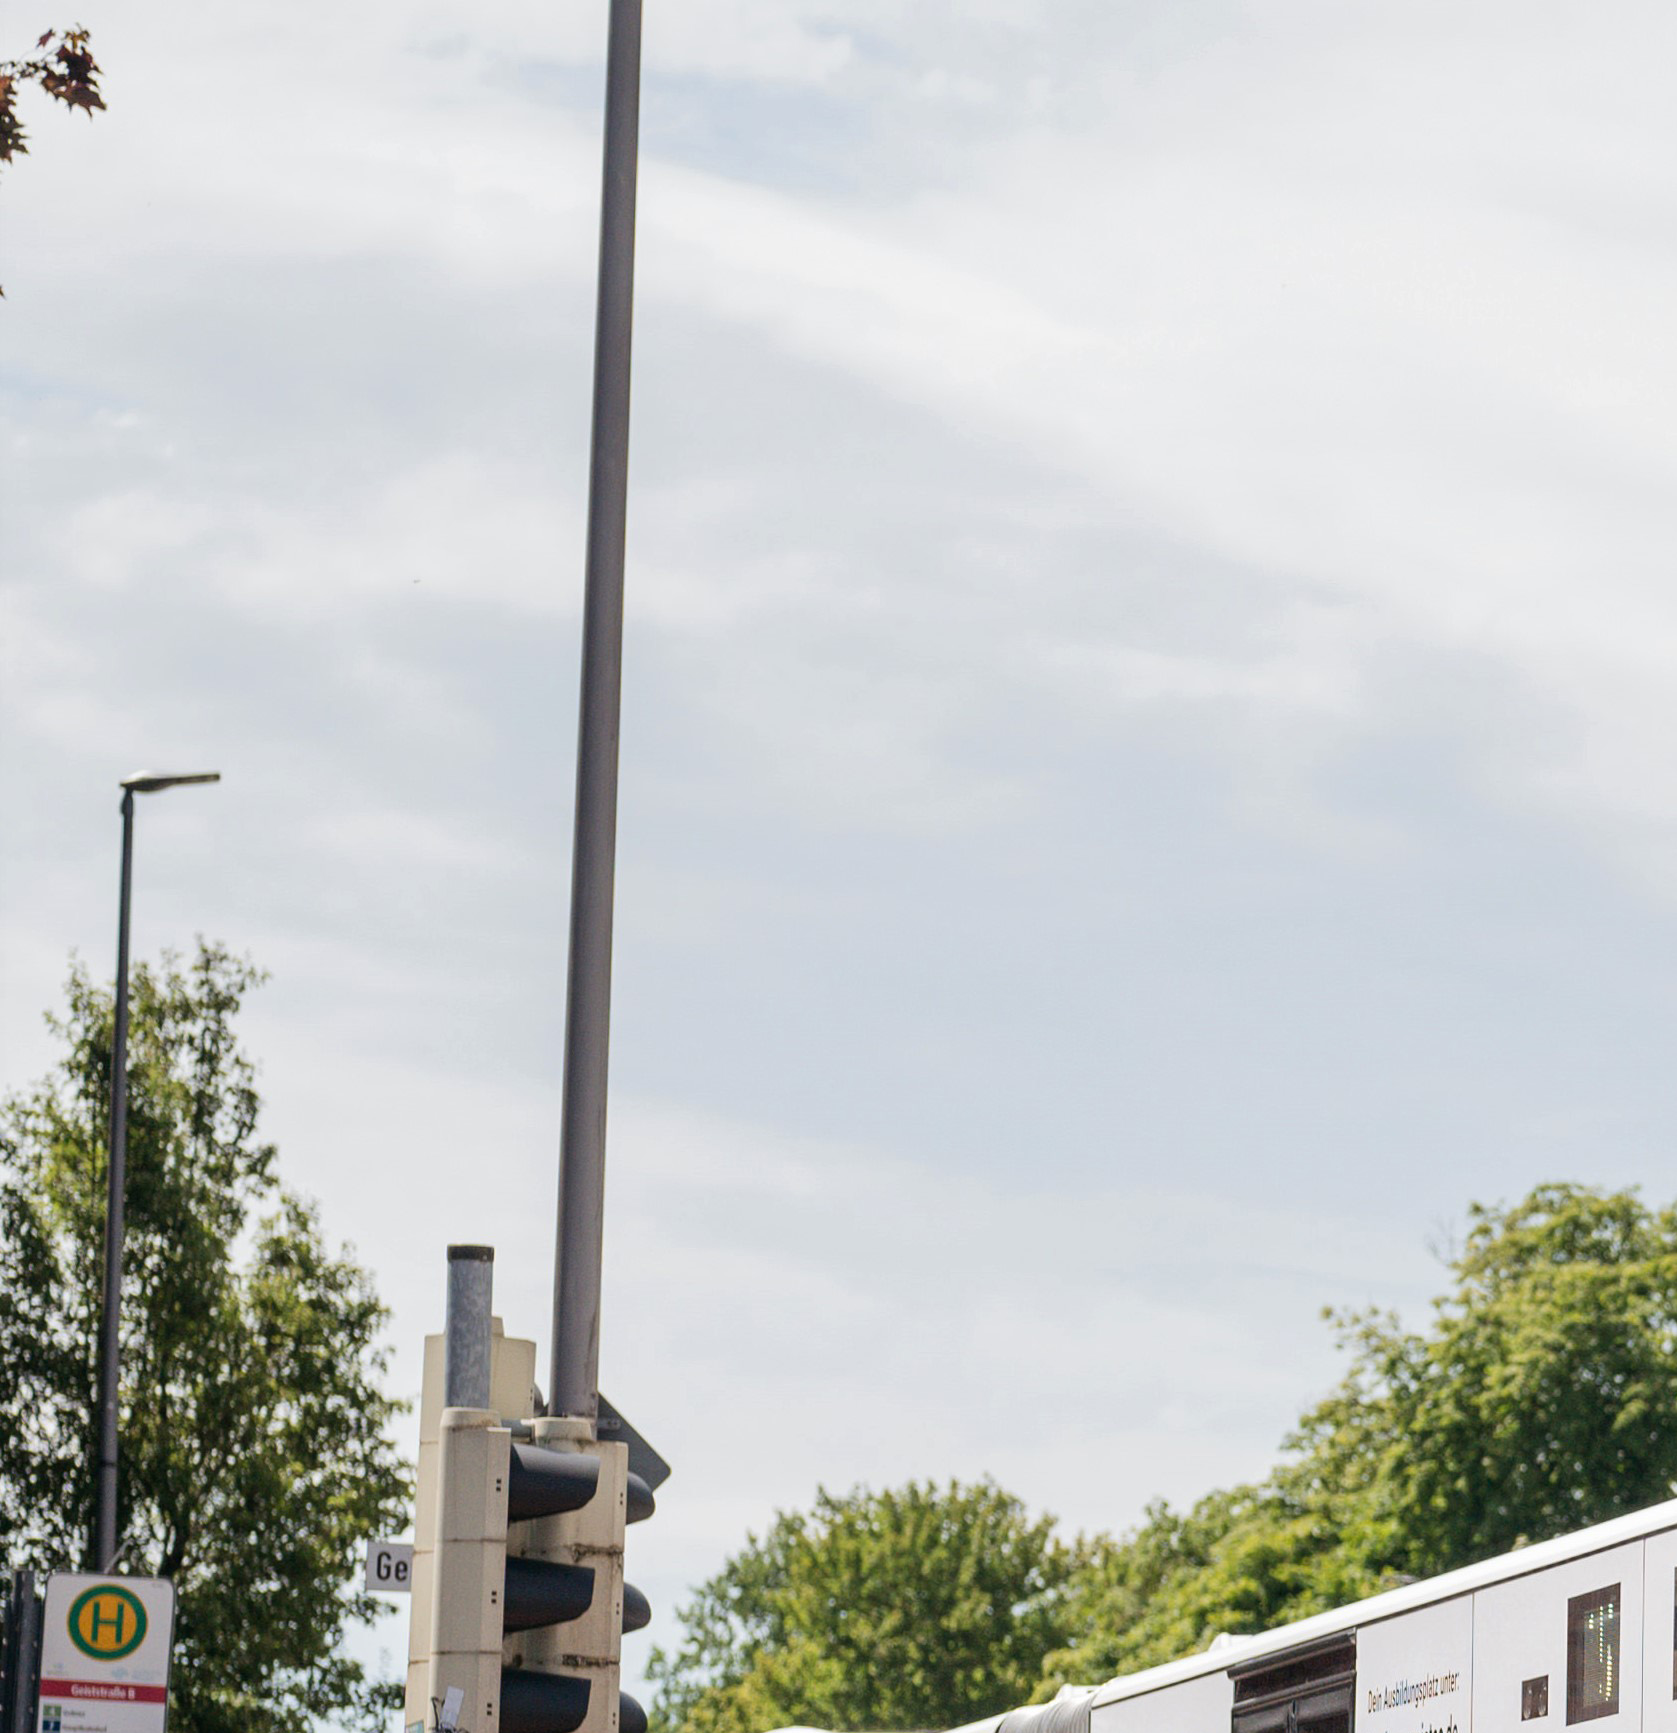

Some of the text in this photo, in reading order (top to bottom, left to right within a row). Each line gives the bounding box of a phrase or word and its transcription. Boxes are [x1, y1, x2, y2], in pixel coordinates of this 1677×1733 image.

[71, 1684, 126, 1699] Geiststraße
[1368, 1670, 1460, 1714] Dein Ausbildungsplatz unter:
